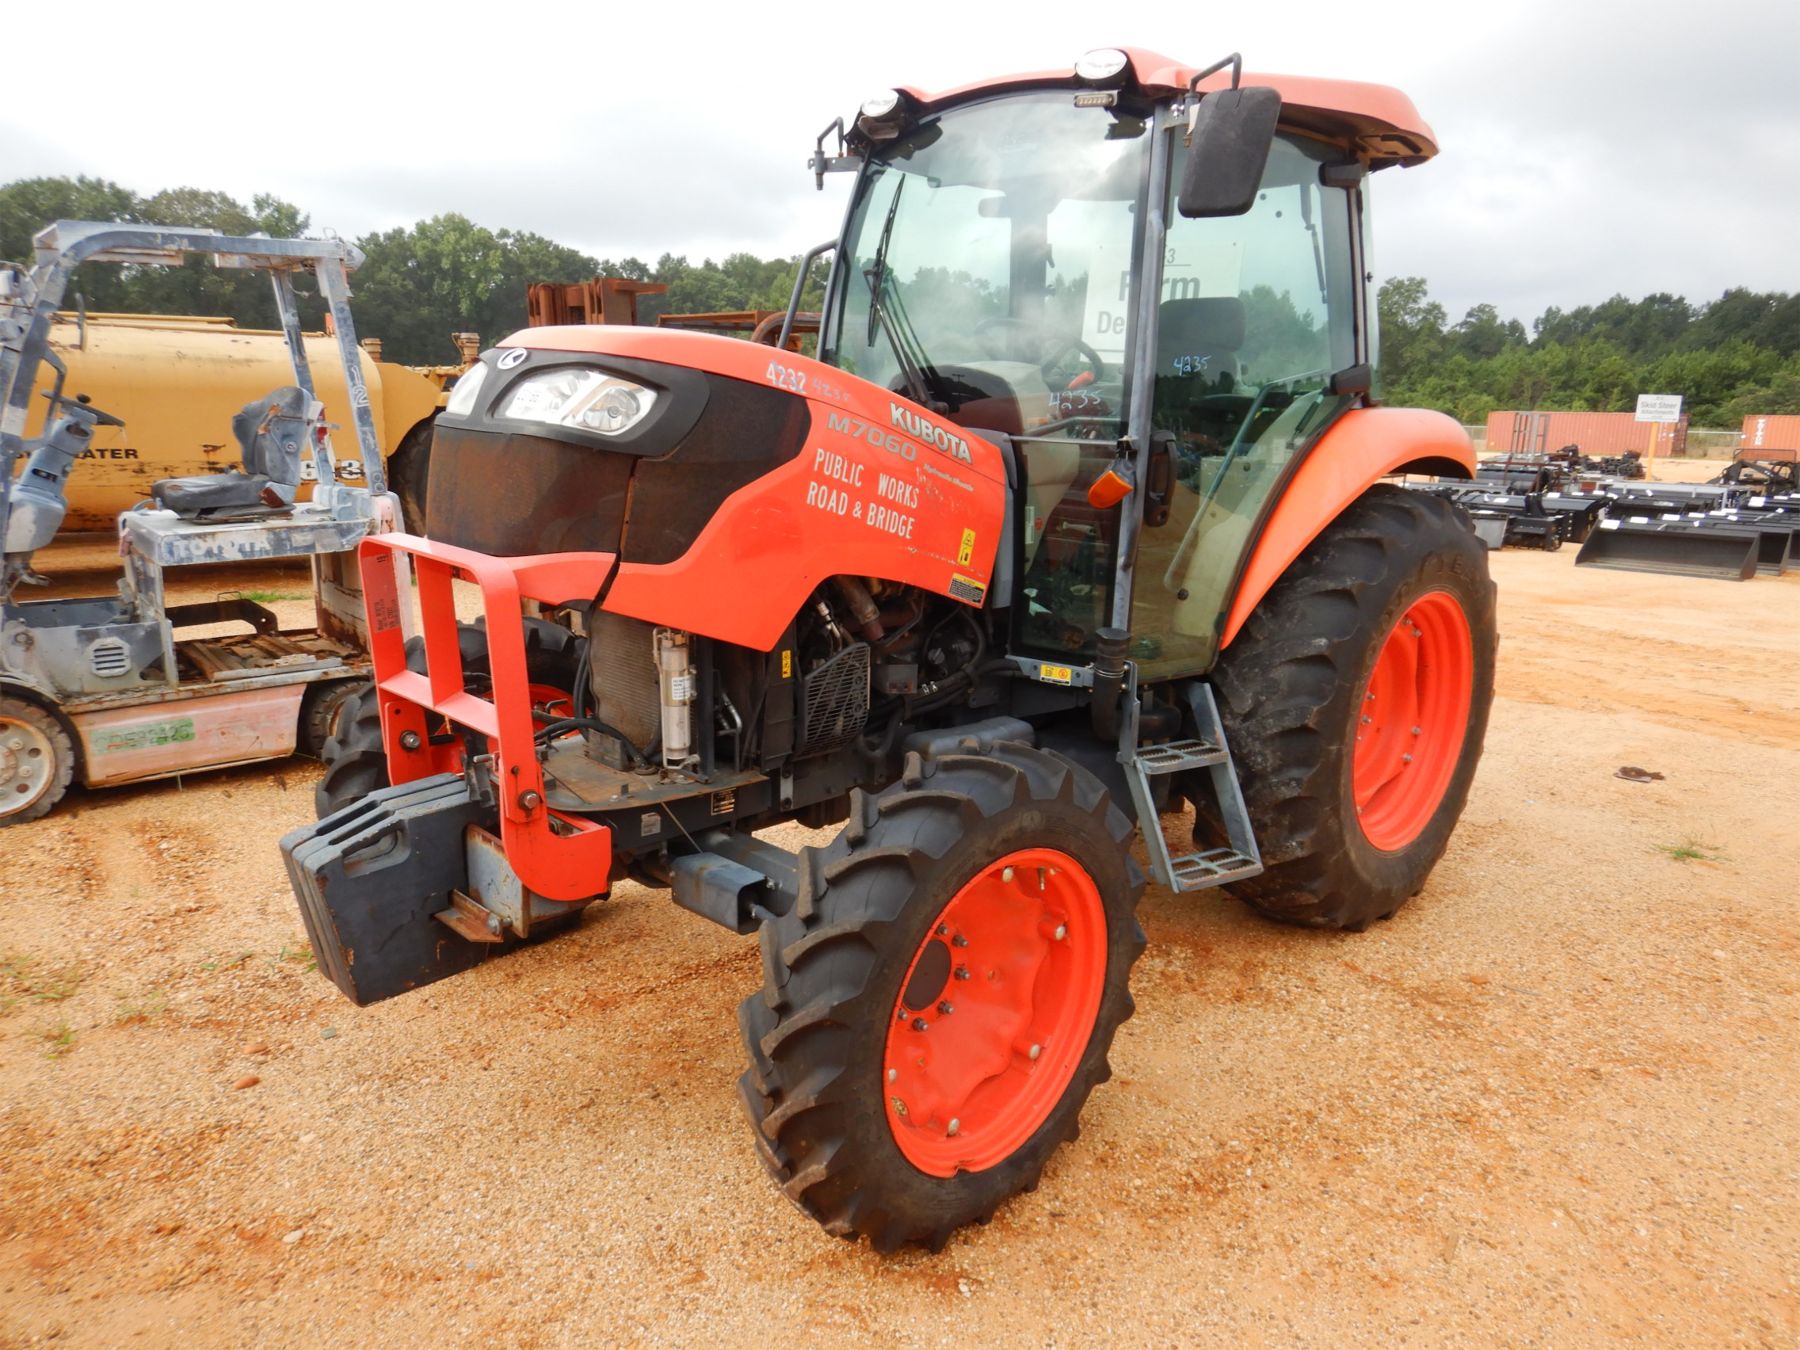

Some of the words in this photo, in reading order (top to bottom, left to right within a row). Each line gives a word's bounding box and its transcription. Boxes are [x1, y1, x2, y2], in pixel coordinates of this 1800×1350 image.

[1119, 270, 1201, 300] Frm
[1173, 354, 1212, 376] 4235
[1048, 390, 1103, 410] 4235
[826, 412, 917, 462] M7060
[889, 401, 973, 465] KUBOTA
[75, 448, 139, 459] ATER
[814, 448, 865, 488] PUBLIC
[877, 473, 920, 509] WORKS
[806, 481, 849, 516] ROAD
[852, 501, 862, 518] &
[866, 503, 916, 540] BRIDGE
